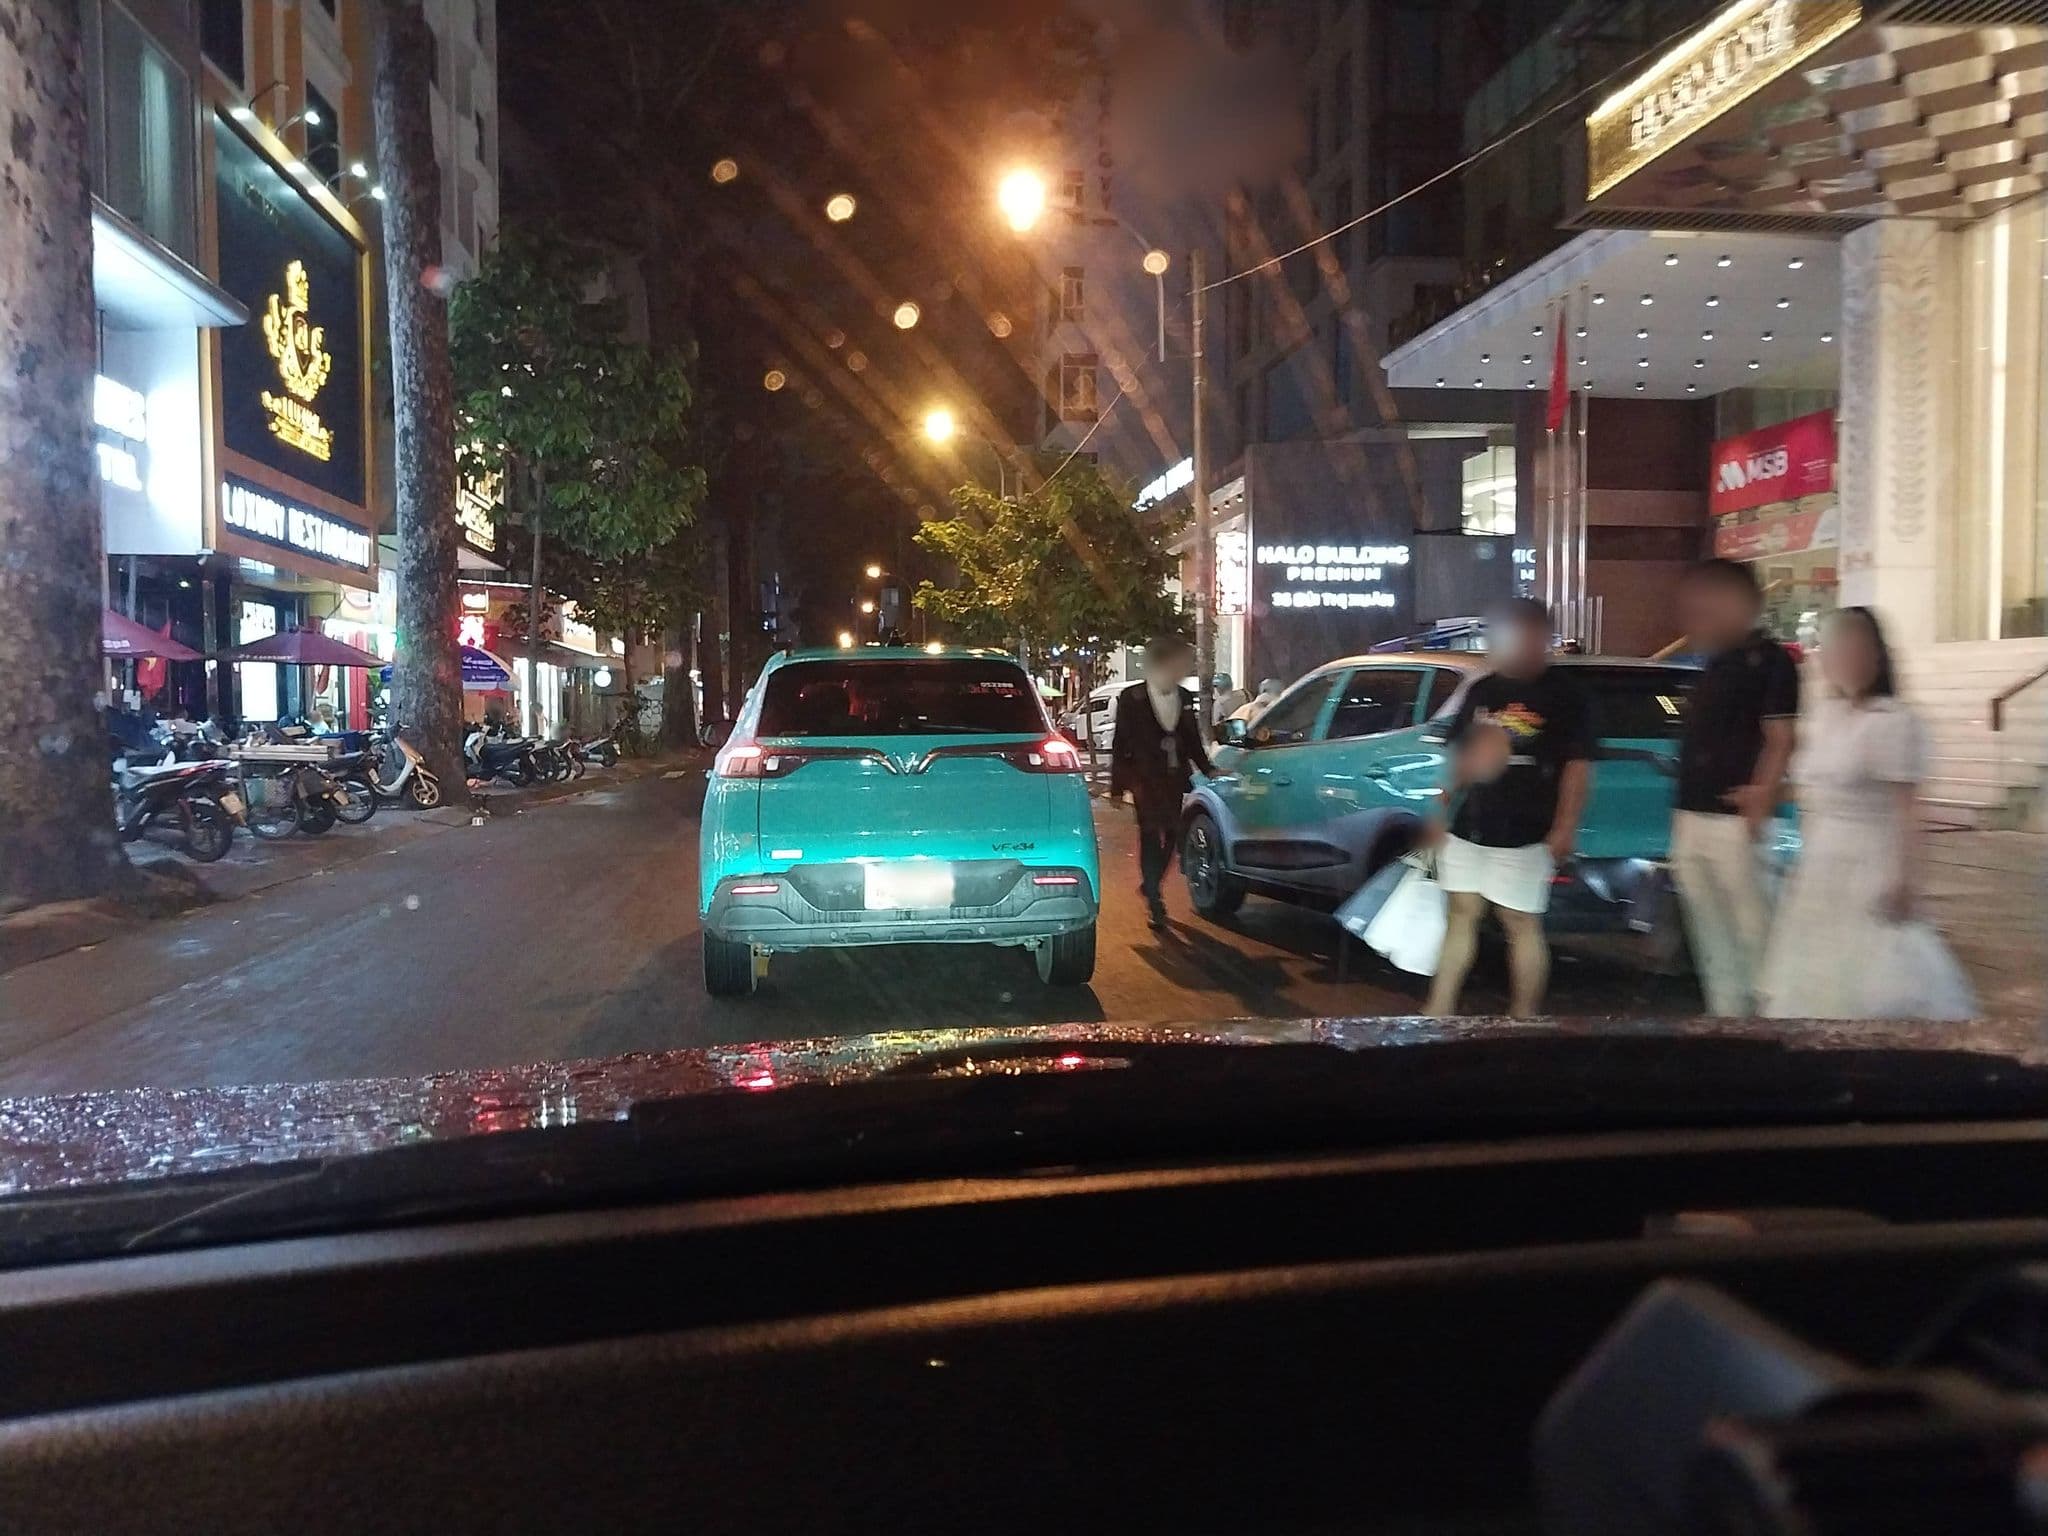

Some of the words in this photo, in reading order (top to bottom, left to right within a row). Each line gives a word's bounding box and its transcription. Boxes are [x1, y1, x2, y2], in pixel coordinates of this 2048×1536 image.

[1746, 450, 1789, 484] MSB
[1256, 545, 1315, 564] HALO
[1316, 545, 1410, 564] BUILDING
[1286, 566, 1382, 581] PREMIUM
